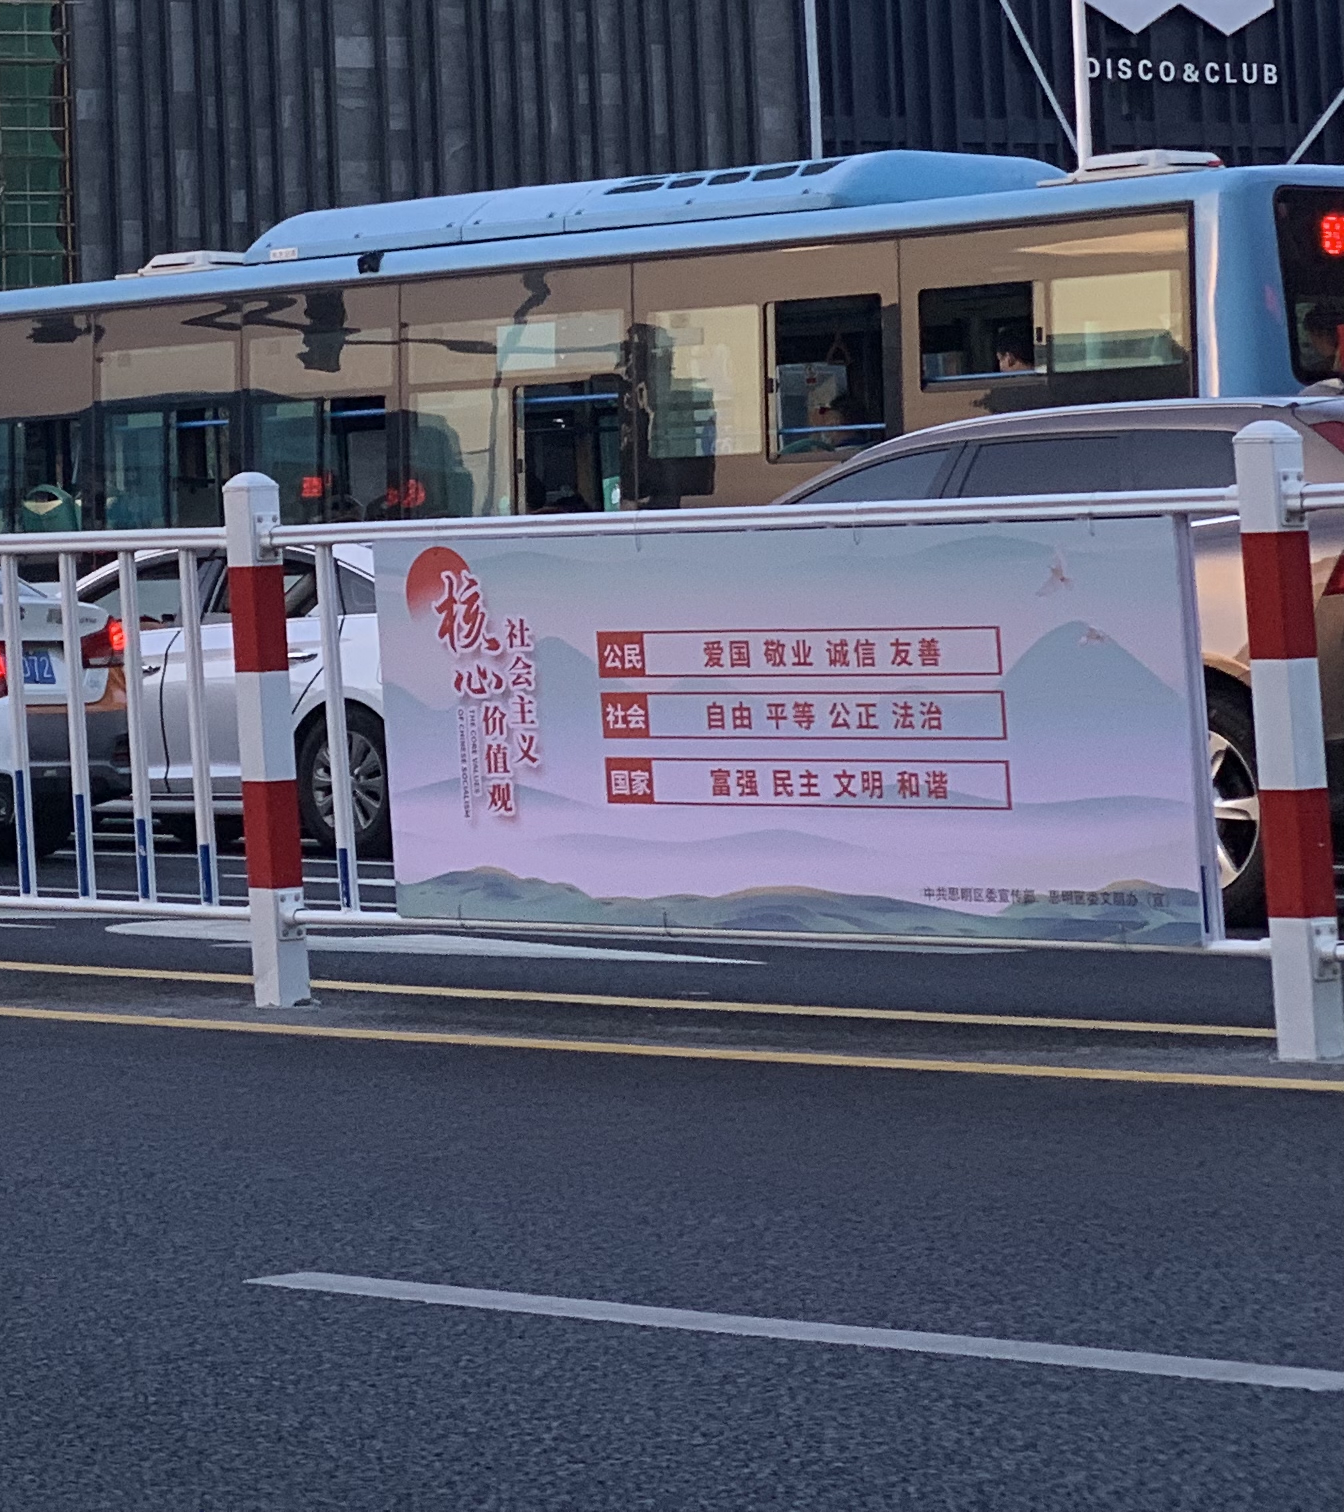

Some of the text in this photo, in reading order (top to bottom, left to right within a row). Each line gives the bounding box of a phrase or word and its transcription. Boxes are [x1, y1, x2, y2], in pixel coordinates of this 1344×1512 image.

[603, 637, 942, 670] 公民 爱国 敬业 诚信 友善
[505, 617, 539, 765] 社会主义
[606, 700, 943, 731] 社会 自由 平等 公正 法治
[481, 704, 514, 813] 价值观
[610, 768, 949, 800] 国家 富强 民主 文明 和谐
